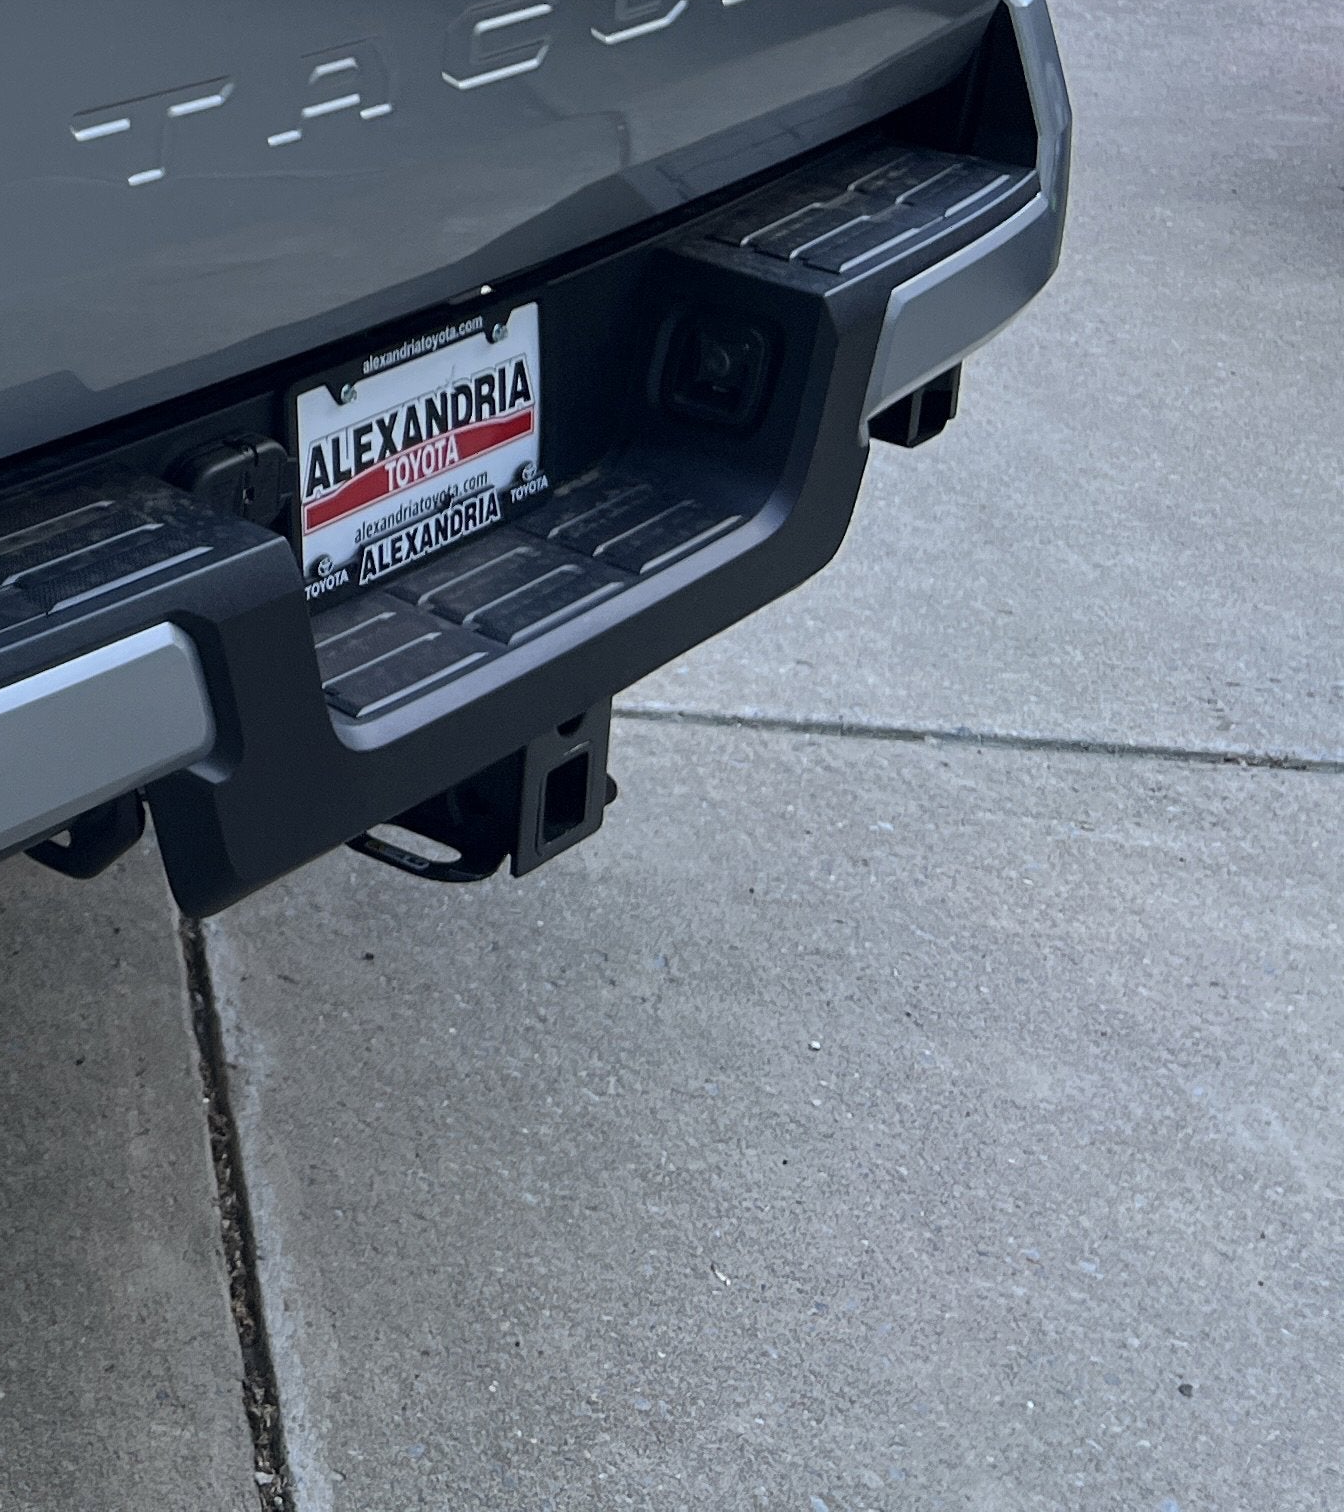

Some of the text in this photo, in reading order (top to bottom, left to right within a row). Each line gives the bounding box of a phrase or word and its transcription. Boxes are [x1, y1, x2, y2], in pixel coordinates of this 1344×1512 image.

[362, 314, 484, 375] alexandriatoyota.com
[305, 358, 533, 499] ALEXANDRIA
[385, 433, 460, 492] TOYOTA
[511, 475, 549, 503] TOYOTA
[354, 470, 488, 544] alexandriatoyota.com
[359, 488, 501, 584] ALEXANDRIA
[304, 568, 350, 601] TOYOTA
